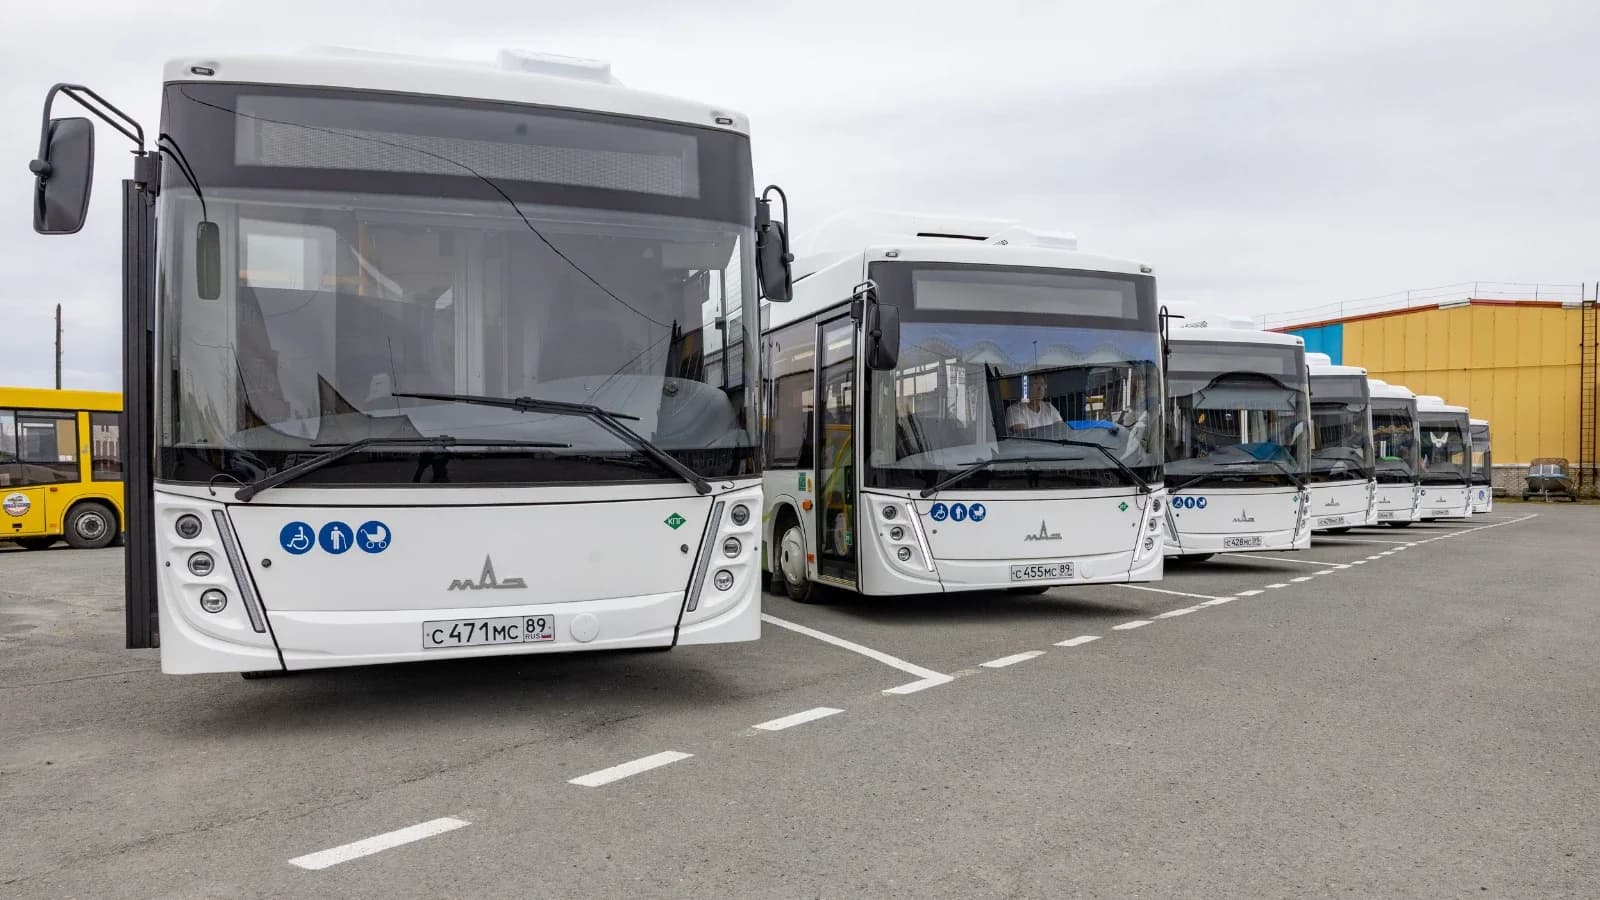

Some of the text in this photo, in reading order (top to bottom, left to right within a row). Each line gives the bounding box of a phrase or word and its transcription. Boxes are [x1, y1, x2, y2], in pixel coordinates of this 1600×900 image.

[1059, 564, 1070, 573] 89
[431, 618, 546, 644] С471МС 89
